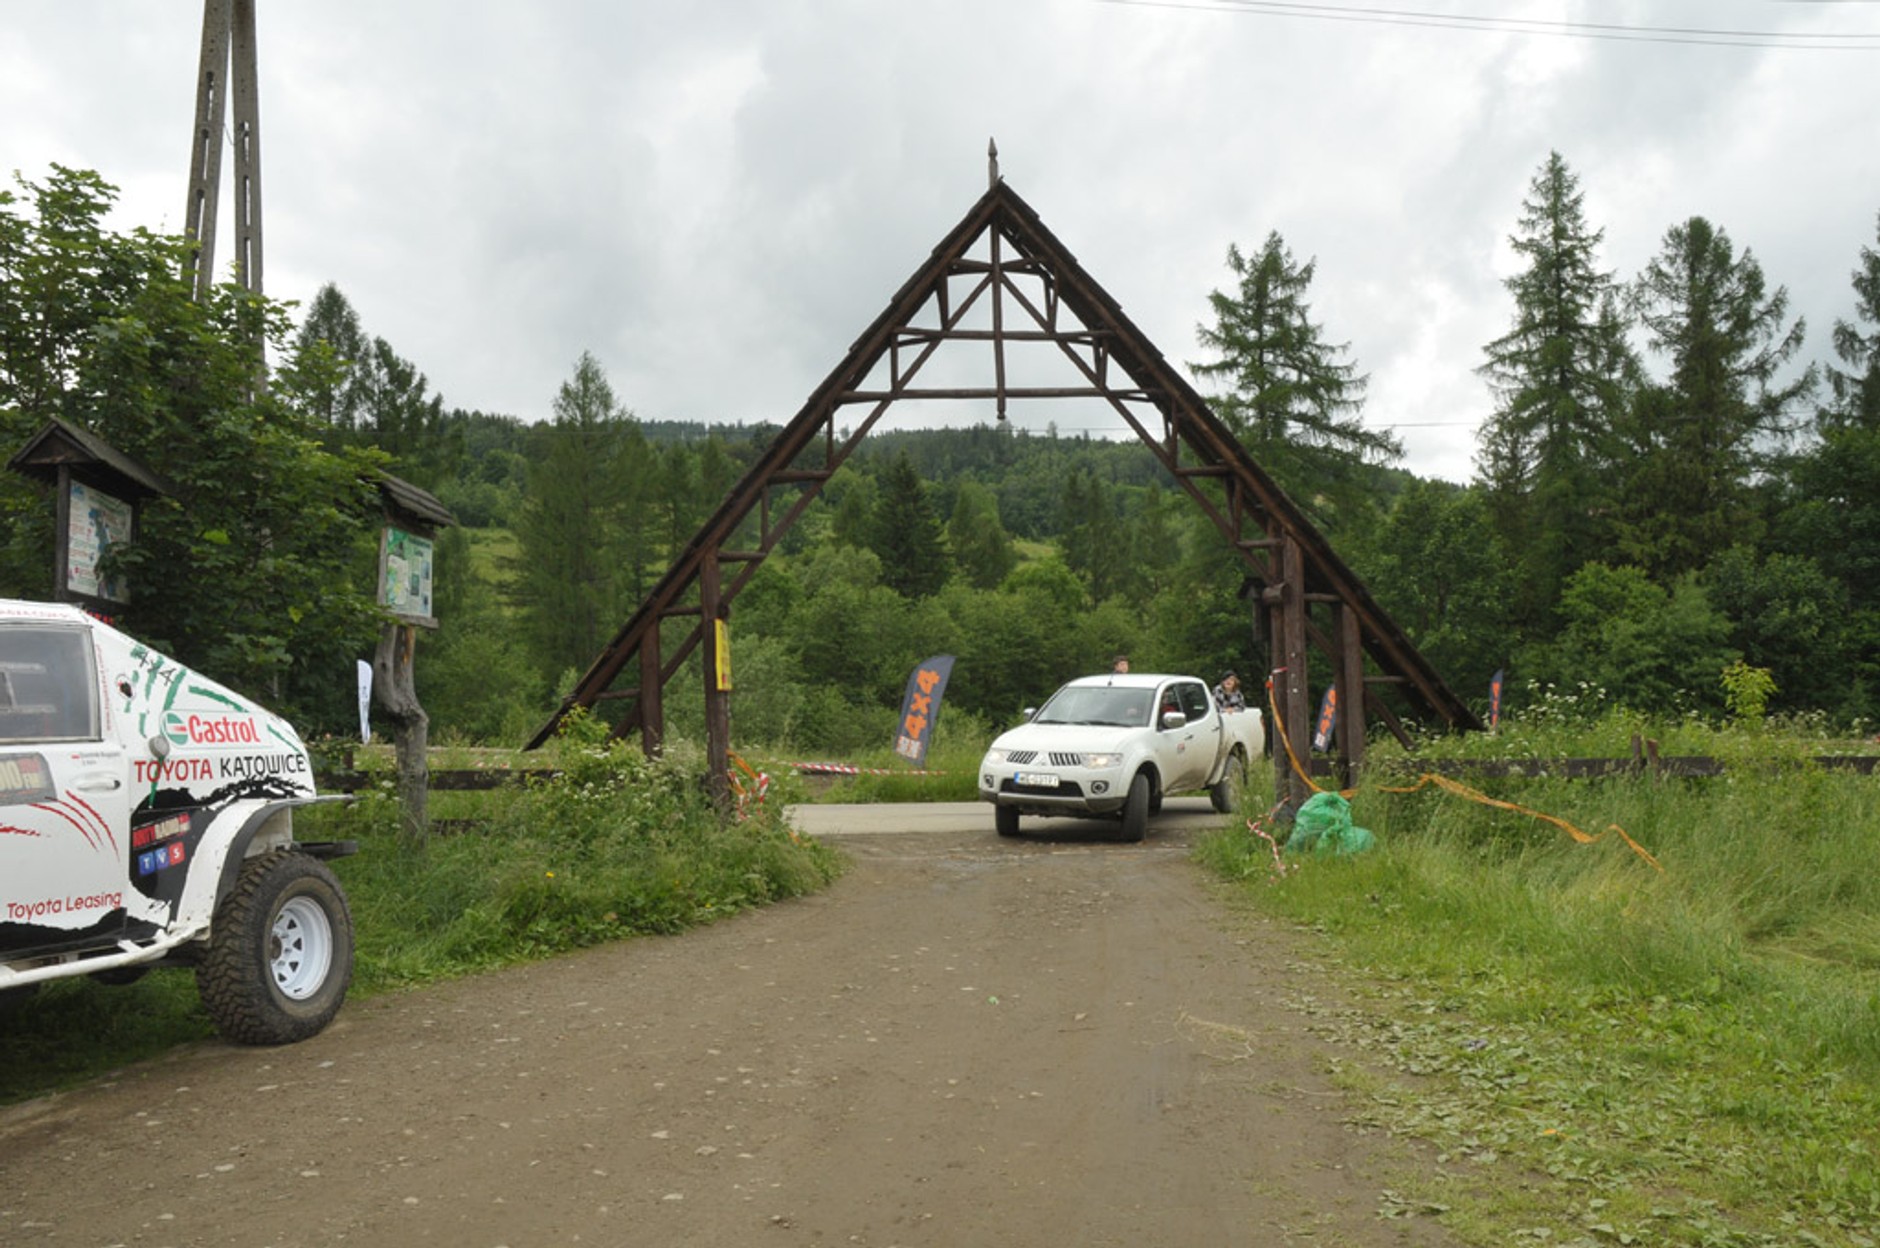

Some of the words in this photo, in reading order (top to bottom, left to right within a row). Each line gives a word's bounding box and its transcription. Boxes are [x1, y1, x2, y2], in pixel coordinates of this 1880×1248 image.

[188, 714, 261, 744] Castrol
[134, 758, 214, 783] TOYOTA
[220, 753, 307, 779] KATOWICE
[7, 899, 62, 921] Toyota
[65, 891, 122, 911] Leasing
